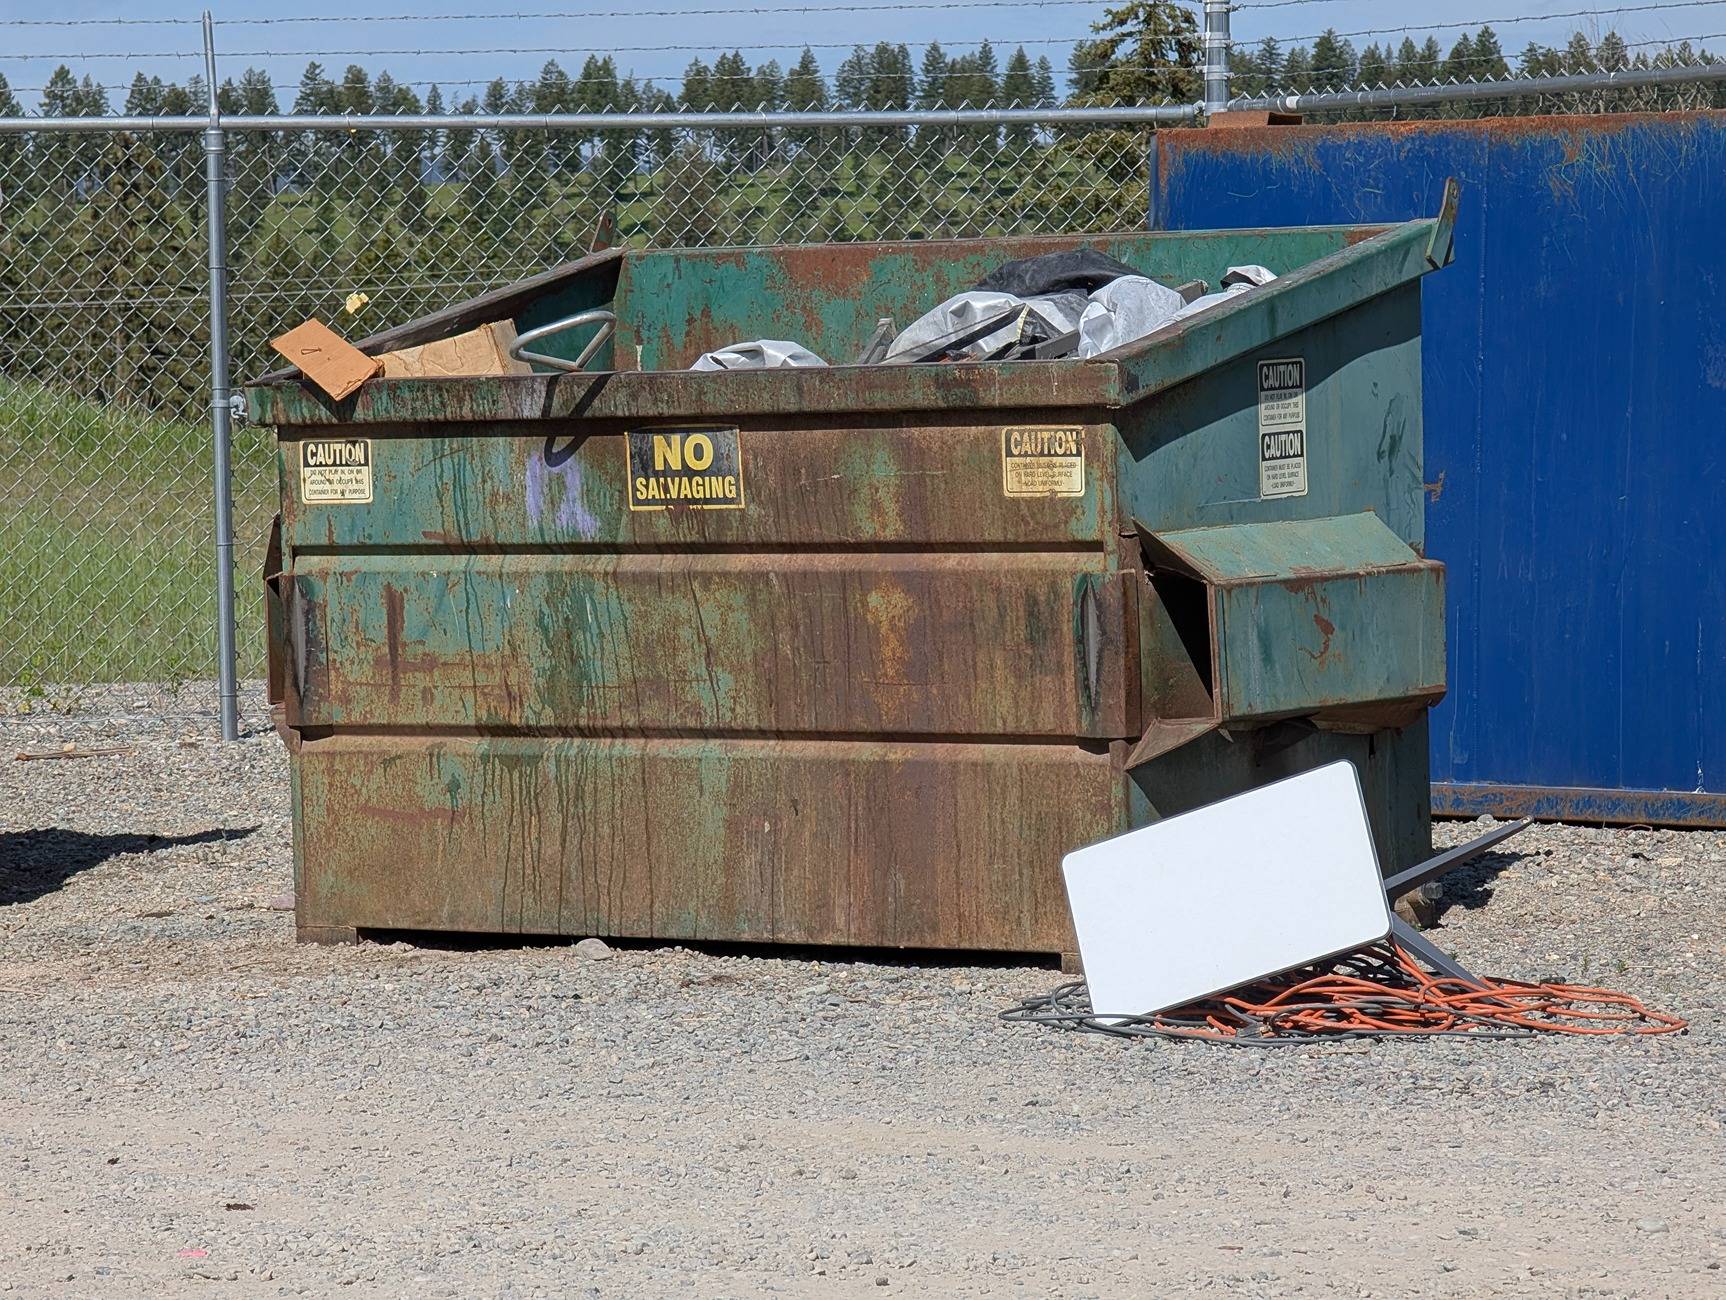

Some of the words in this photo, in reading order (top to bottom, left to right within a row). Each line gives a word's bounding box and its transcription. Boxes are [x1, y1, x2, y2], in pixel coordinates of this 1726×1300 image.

[1262, 363, 1300, 389] CAUTION
[307, 442, 365, 466] CAUTION
[653, 433, 714, 471] NO
[1010, 430, 1077, 455] CAUTION
[1264, 432, 1301, 459] CAUTION
[635, 475, 737, 500] SALVAGING
